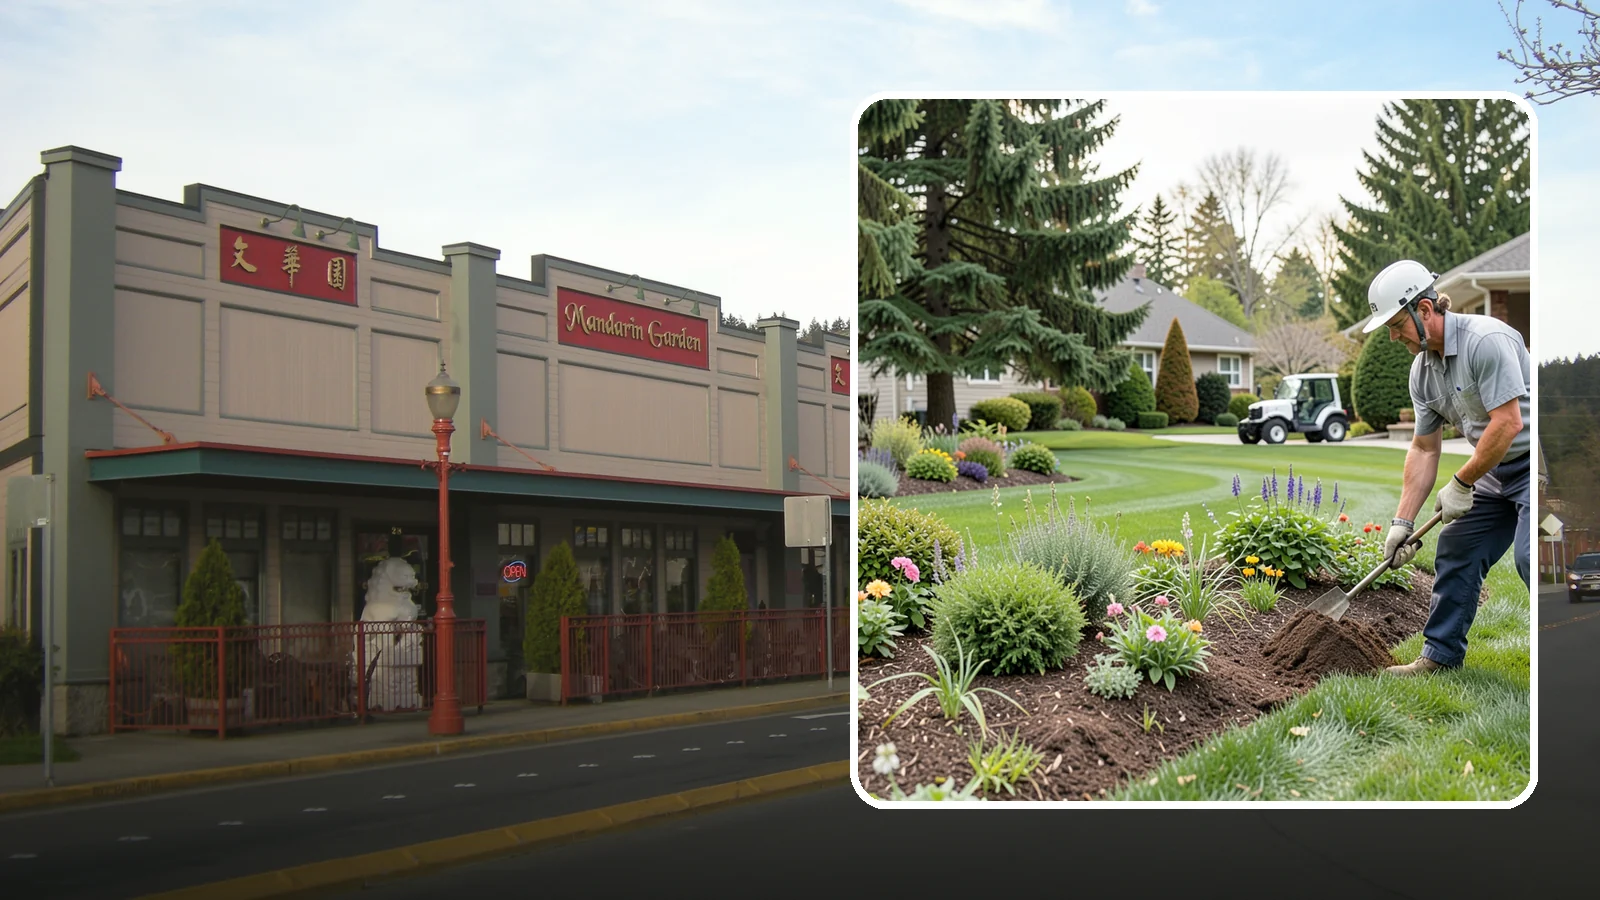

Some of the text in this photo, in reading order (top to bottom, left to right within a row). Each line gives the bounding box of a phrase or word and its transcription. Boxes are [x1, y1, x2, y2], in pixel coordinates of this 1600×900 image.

[231, 235, 346, 290] 文華園
[565, 302, 701, 352] Mandarin Garden
[503, 565, 527, 578] OPEN
